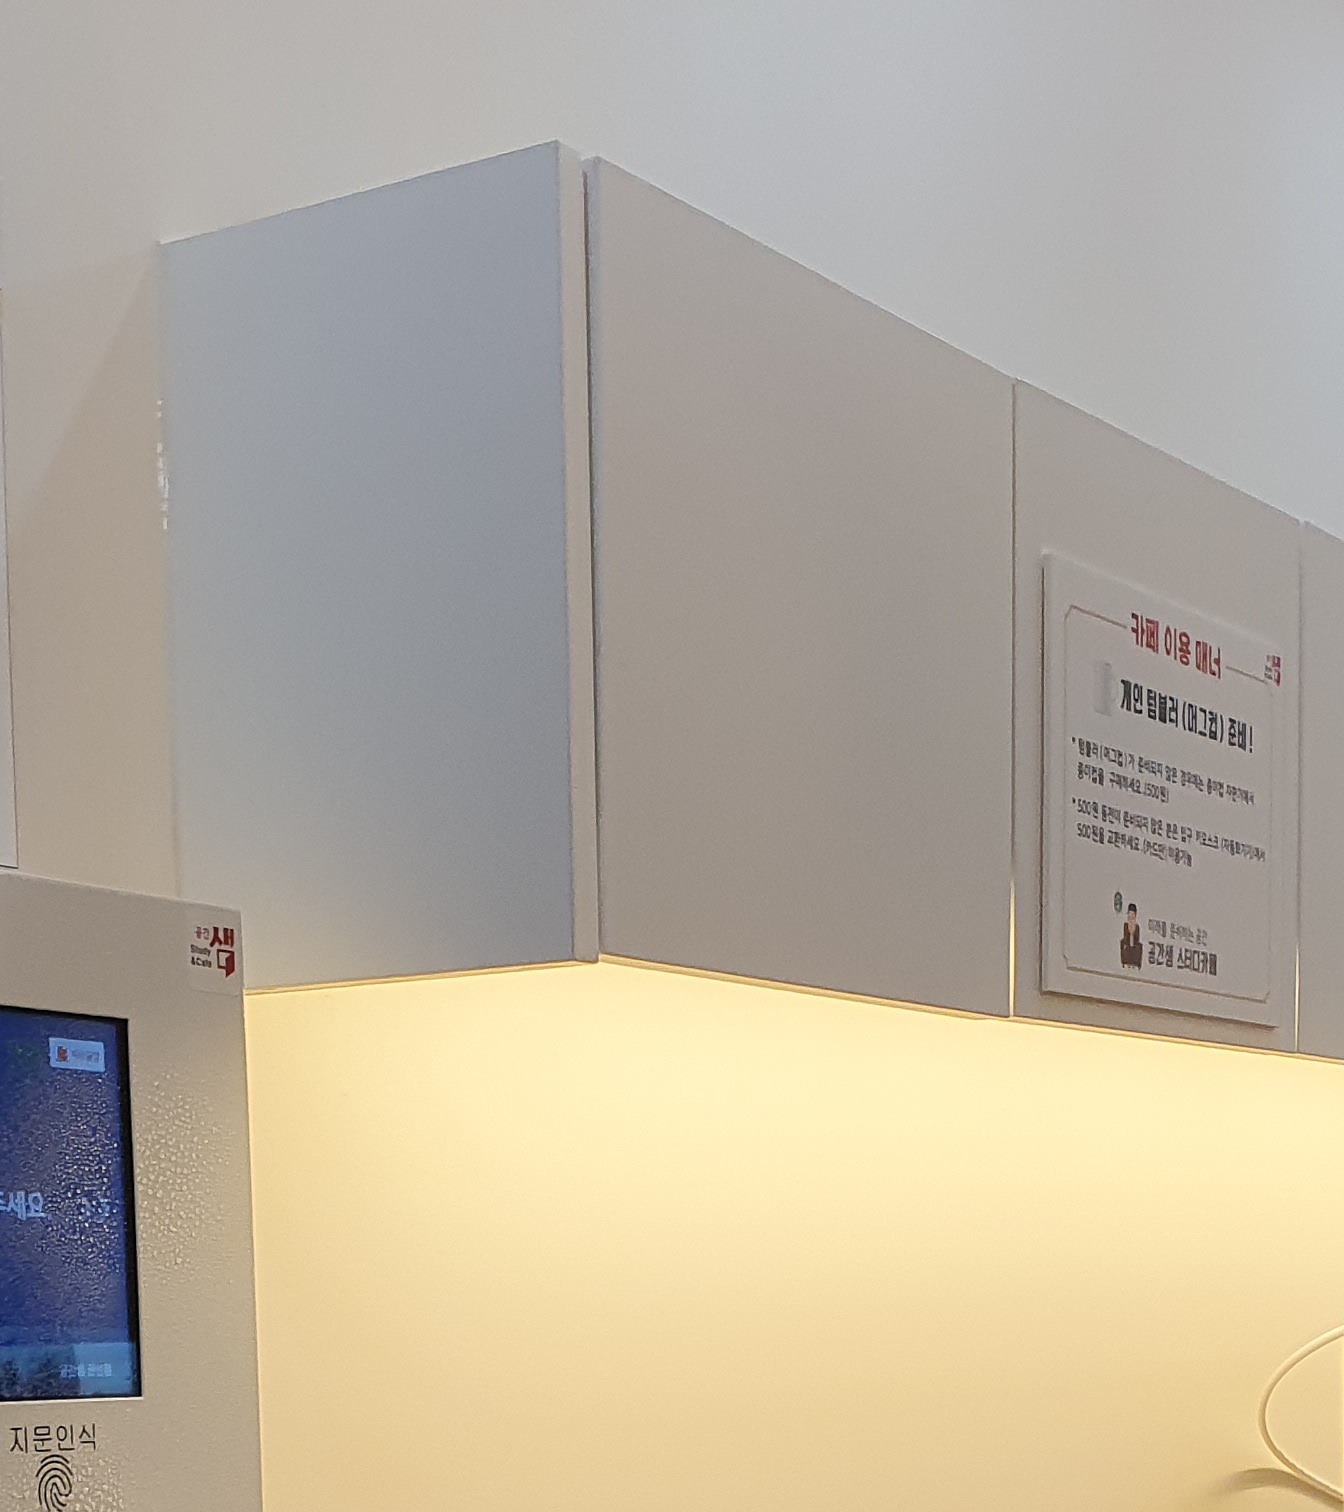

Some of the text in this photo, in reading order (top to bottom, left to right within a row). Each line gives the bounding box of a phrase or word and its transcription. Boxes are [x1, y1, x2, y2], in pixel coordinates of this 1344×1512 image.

[1130, 612, 1160, 655] 카페
[1164, 625, 1191, 667] 이용
[1196, 640, 1221, 680] 매너
[1120, 678, 1143, 715] 개인
[1146, 688, 1179, 731] 텀블러
[1182, 701, 1224, 744] (머그컵)
[9, 1423, 97, 1454] 지문인식
